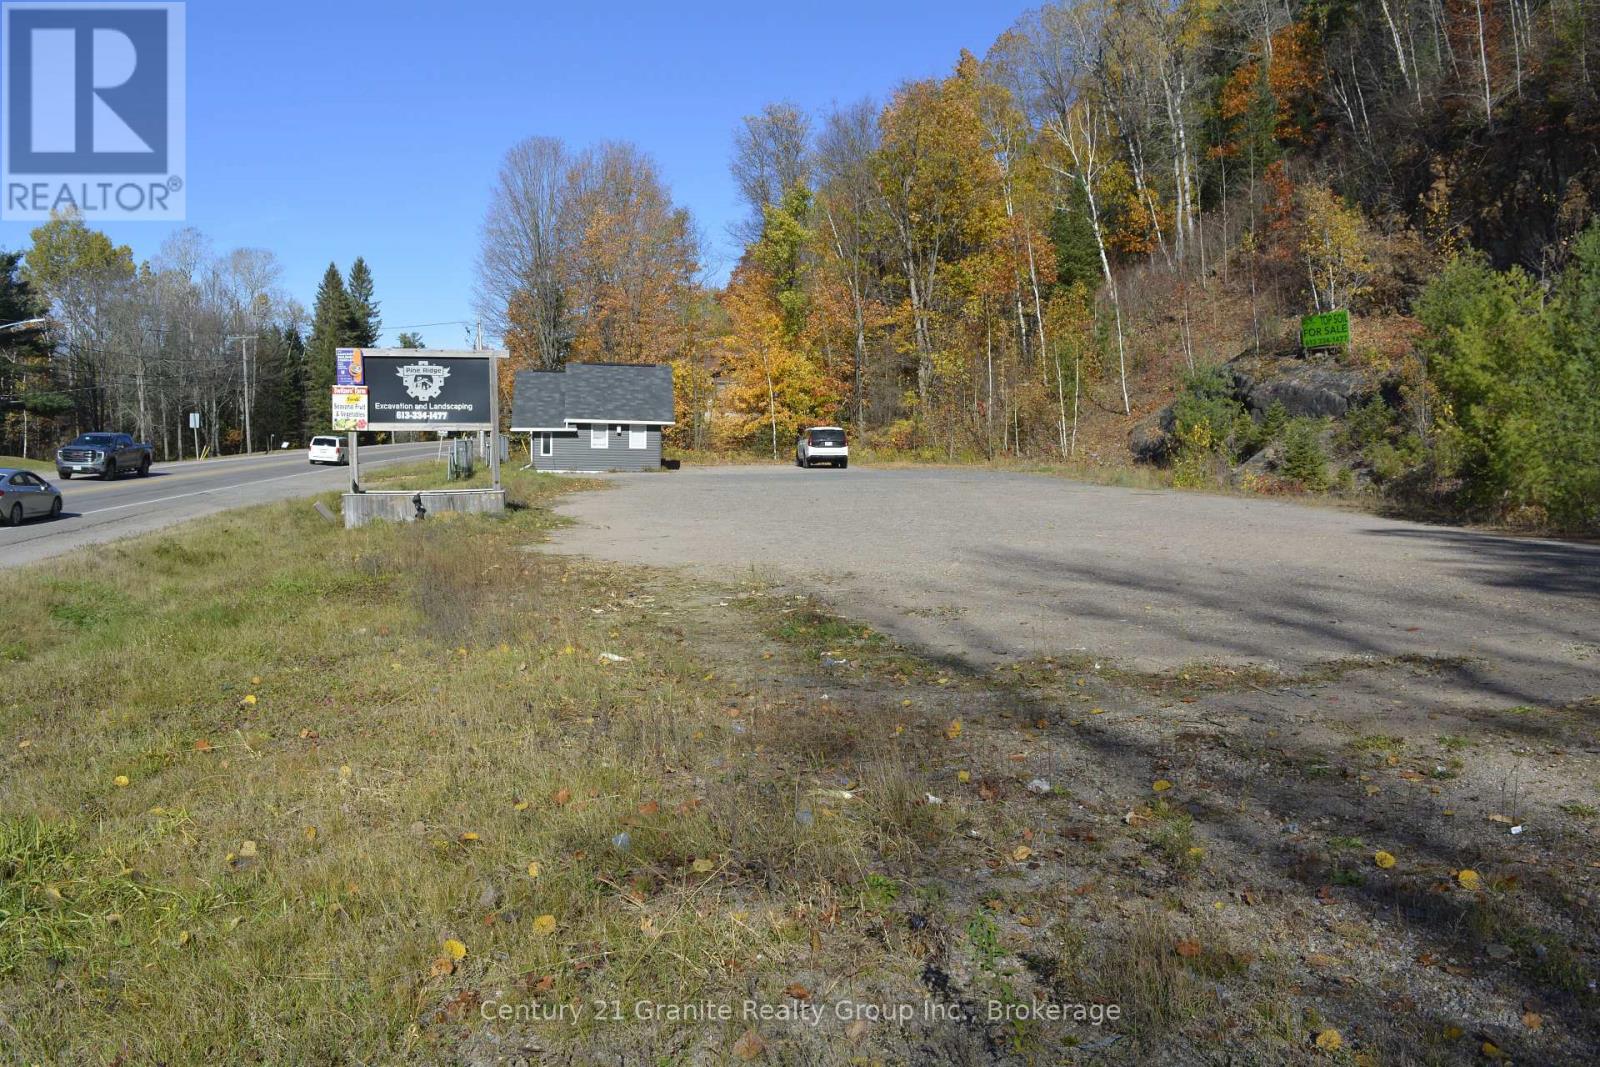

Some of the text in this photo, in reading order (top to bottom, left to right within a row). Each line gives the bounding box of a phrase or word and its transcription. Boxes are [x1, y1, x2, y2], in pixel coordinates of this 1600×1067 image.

[1303, 324, 1348, 337] FOR SALE
[422, 367, 442, 375] Ridge
[375, 402, 473, 411] Excavation and Landscaping
